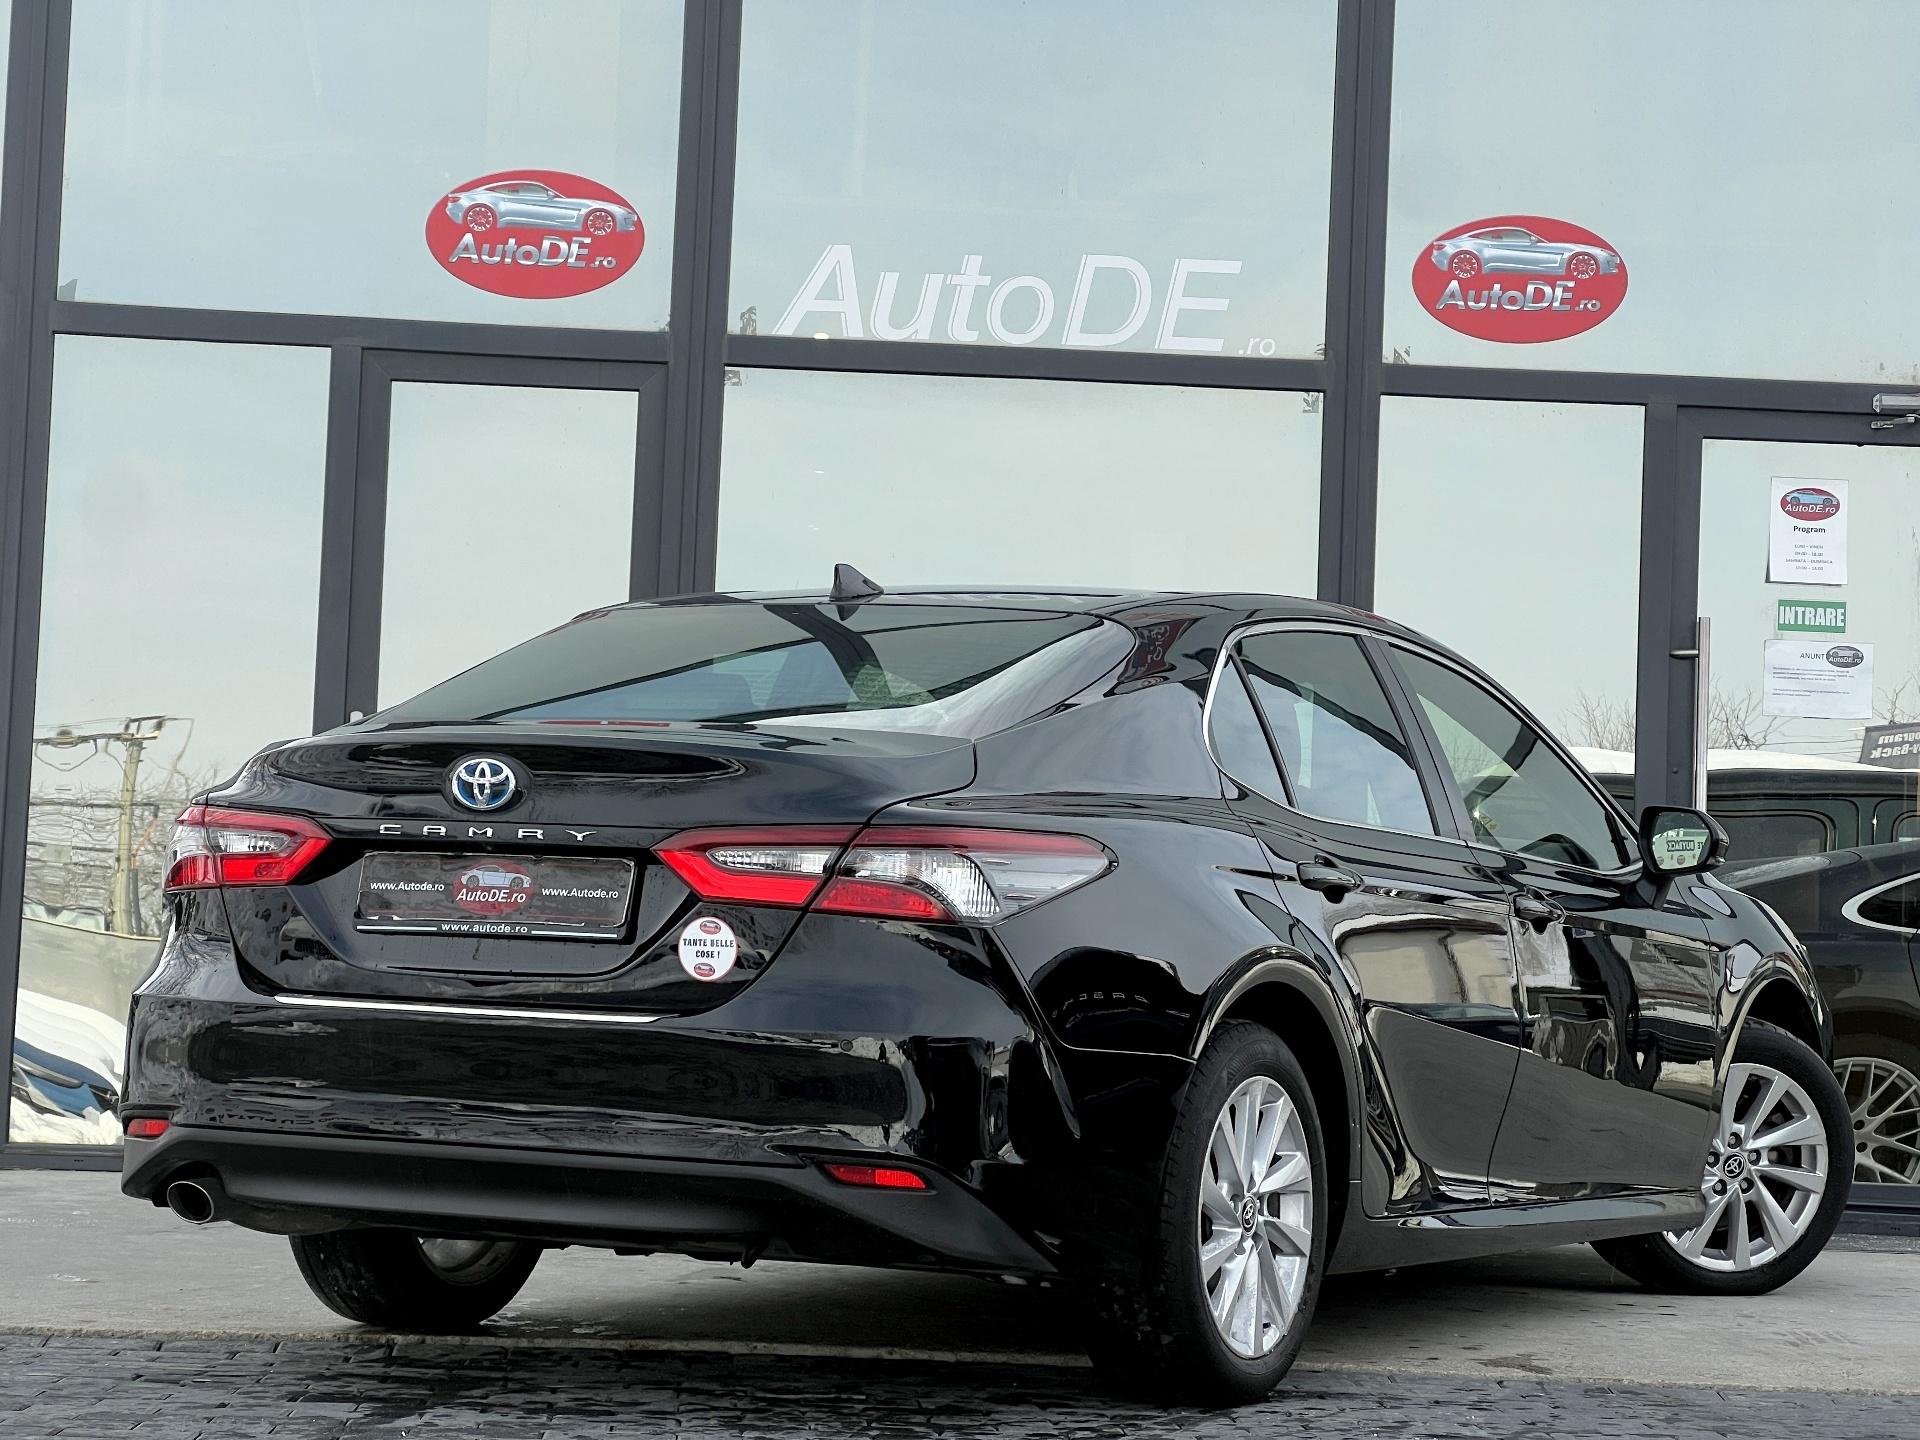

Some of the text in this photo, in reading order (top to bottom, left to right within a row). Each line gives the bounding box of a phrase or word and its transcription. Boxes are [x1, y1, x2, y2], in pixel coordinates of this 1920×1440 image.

[1785, 504, 1836, 513] AutoDE.ro
[1793, 525, 1826, 534] Program
[1778, 605, 1845, 627] INTRARE
[379, 824, 598, 842] CAMRY
[370, 881, 445, 891] www.Autode.ro
[456, 888, 527, 903] AutoDE.ro
[541, 888, 619, 899] www.Autode.ro
[441, 923, 528, 933] www.autode.ro
[683, 938, 735, 948] TANTE BELLE
[695, 950, 715, 959] COSE
